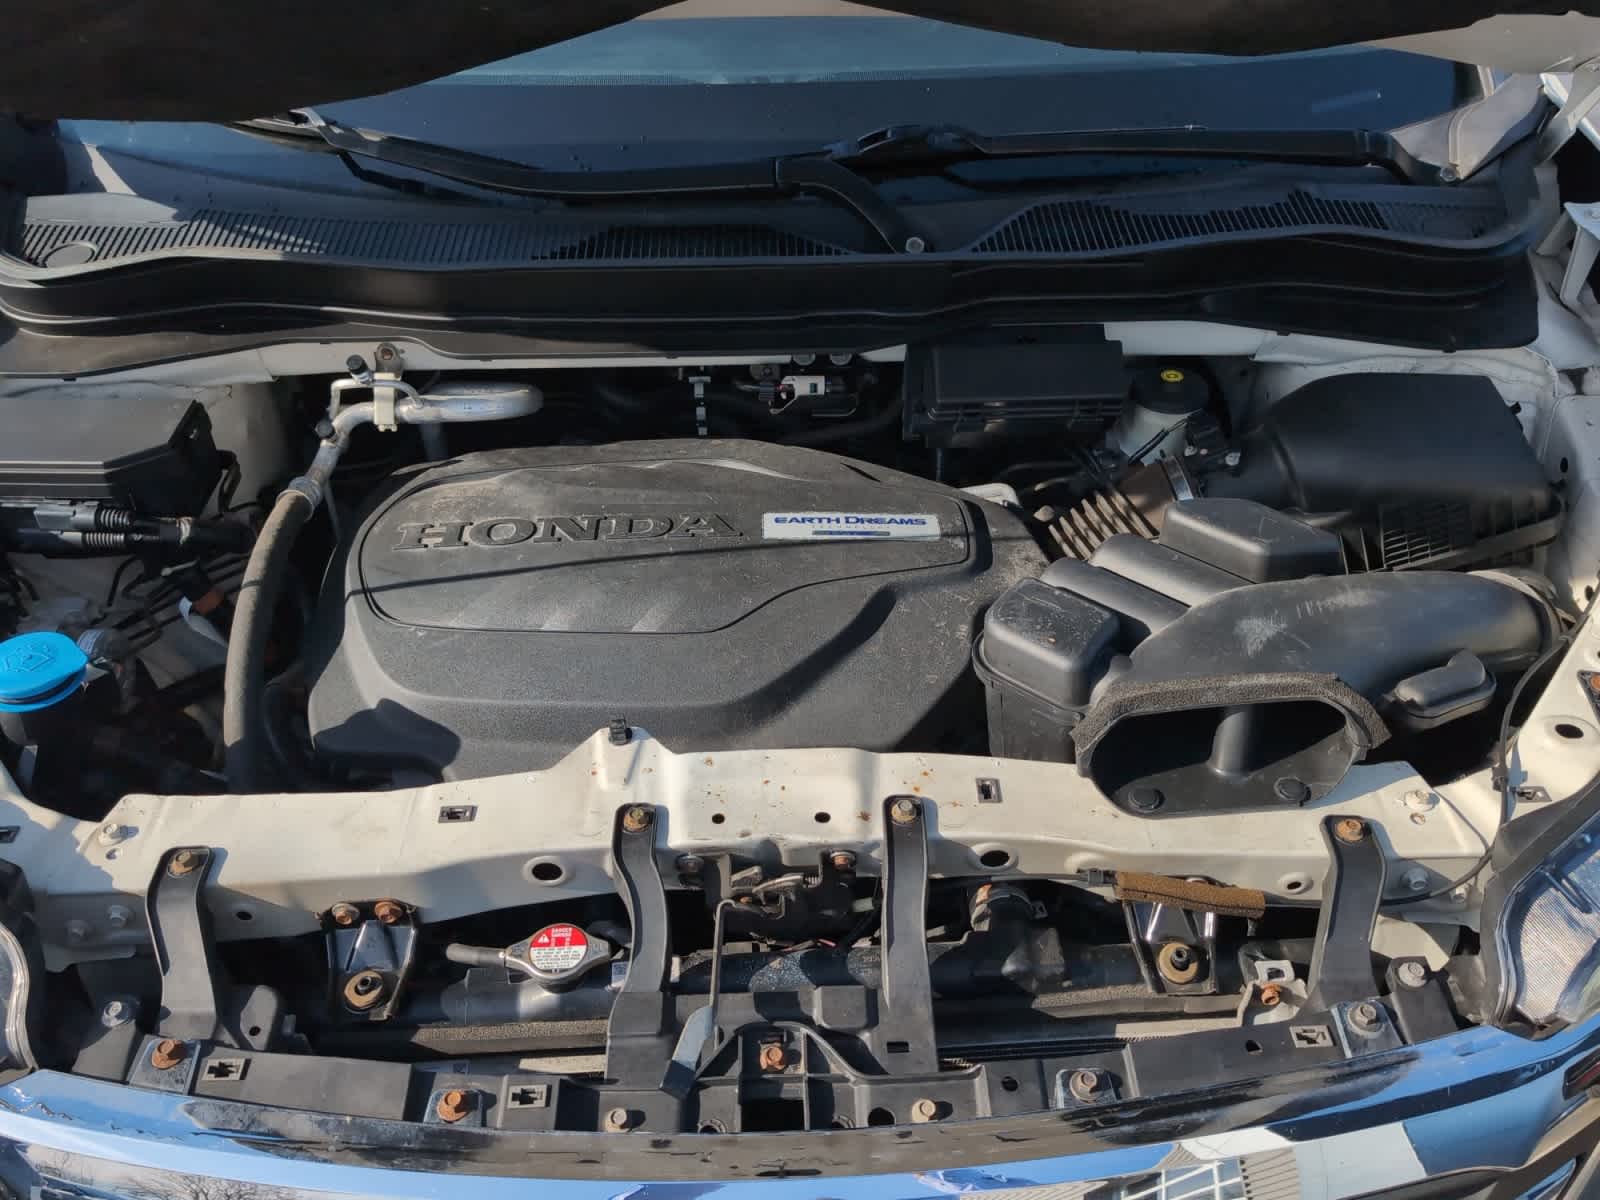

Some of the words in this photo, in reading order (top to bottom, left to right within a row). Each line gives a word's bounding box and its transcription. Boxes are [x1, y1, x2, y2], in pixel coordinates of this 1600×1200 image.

[392, 512, 744, 550] HONDA
[774, 516, 841, 524] EARTH
[844, 516, 927, 526] DREAMS
